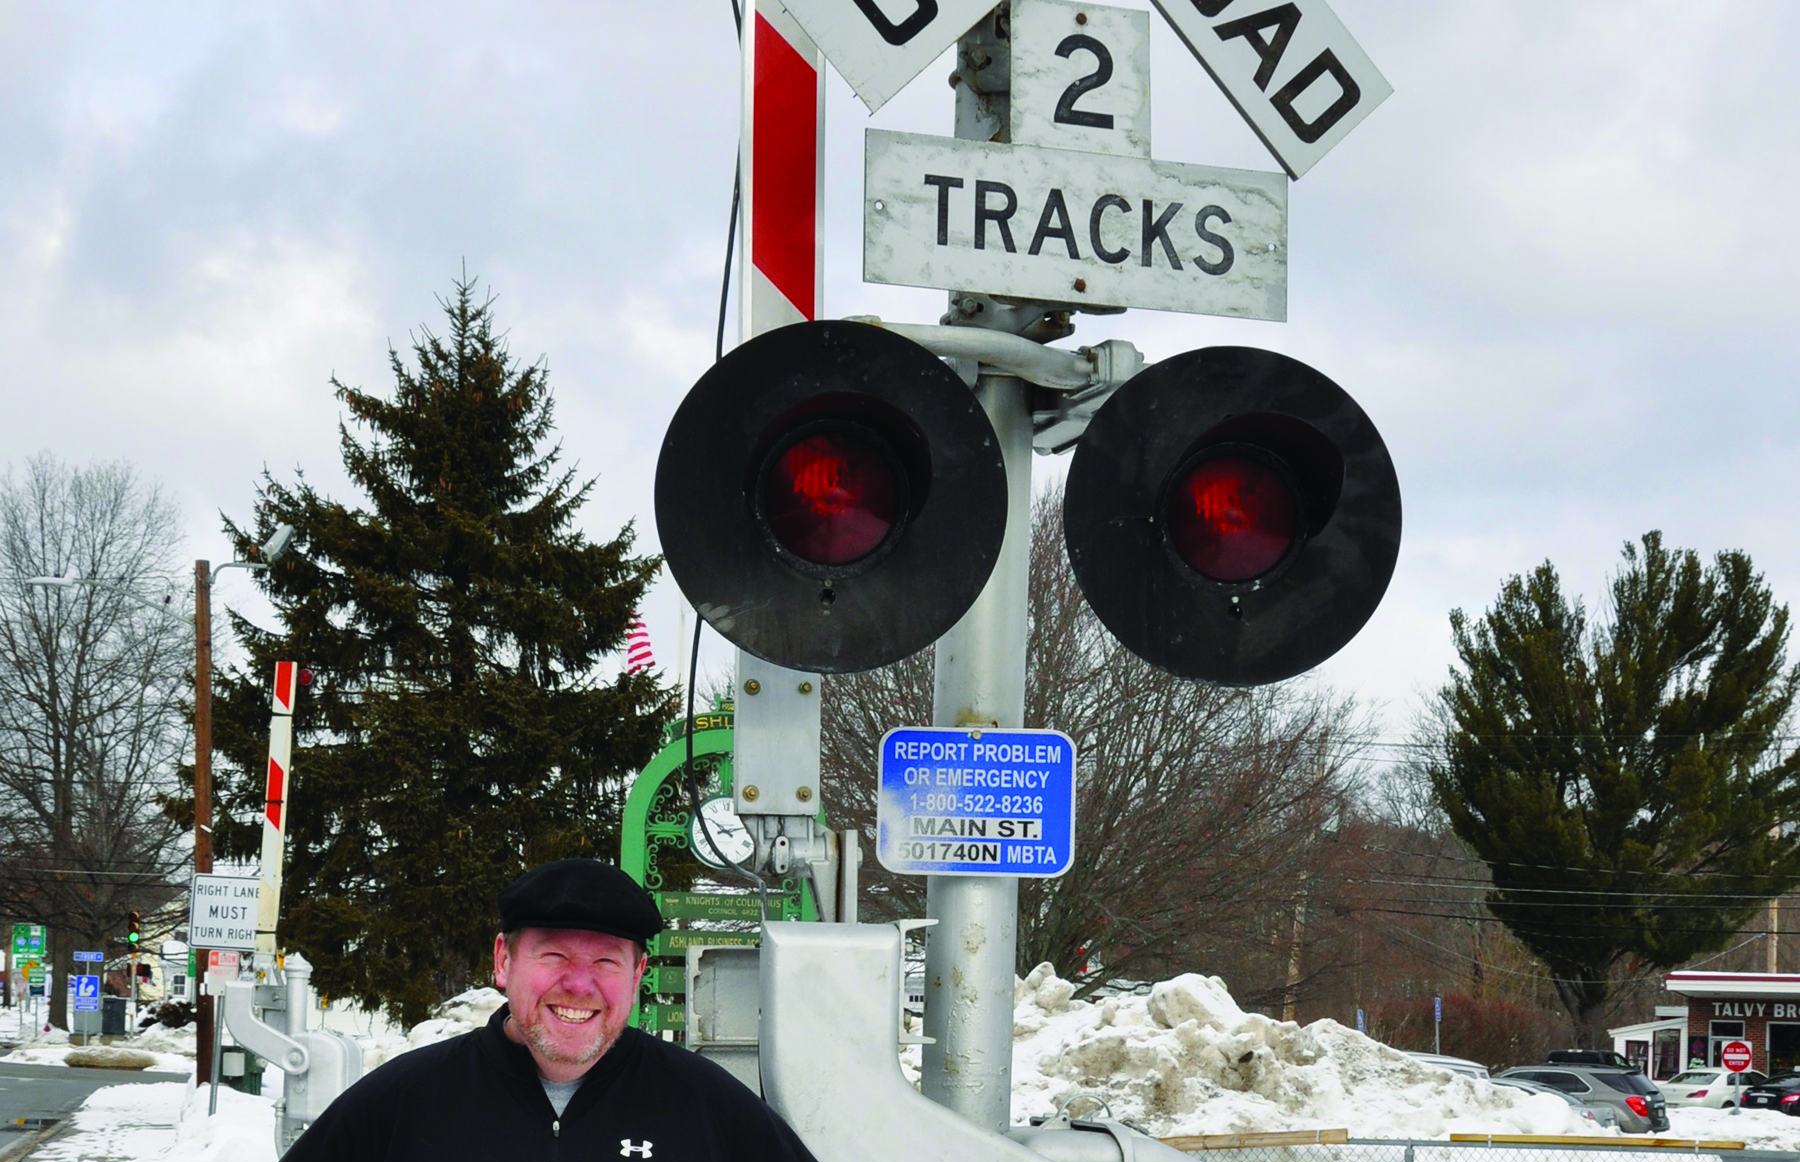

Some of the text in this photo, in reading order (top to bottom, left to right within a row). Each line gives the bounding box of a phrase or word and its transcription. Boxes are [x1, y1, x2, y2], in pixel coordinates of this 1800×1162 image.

[1053, 34, 1115, 130] 2
[1190, 0, 1361, 144] AD
[923, 172, 1235, 277] TRACKS
[894, 741, 1061, 764] REPORT PROBLEM
[904, 767, 1050, 789] OR EMERGENCY
[910, 792, 1043, 814] 1-800-522-8236
[913, 818, 1038, 838] MAIN ST.
[1007, 845, 1057, 865] MBTA
[197, 884, 229, 897] RIGHT
[685, 896, 720, 906] KNIGHTS
[724, 898, 735, 906] of
[209, 905, 247, 920] MUST
[194, 926, 223, 939] TURN
[669, 935, 704, 948] ASHLAND
[1712, 1002, 1800, 1018] TALVY BR
